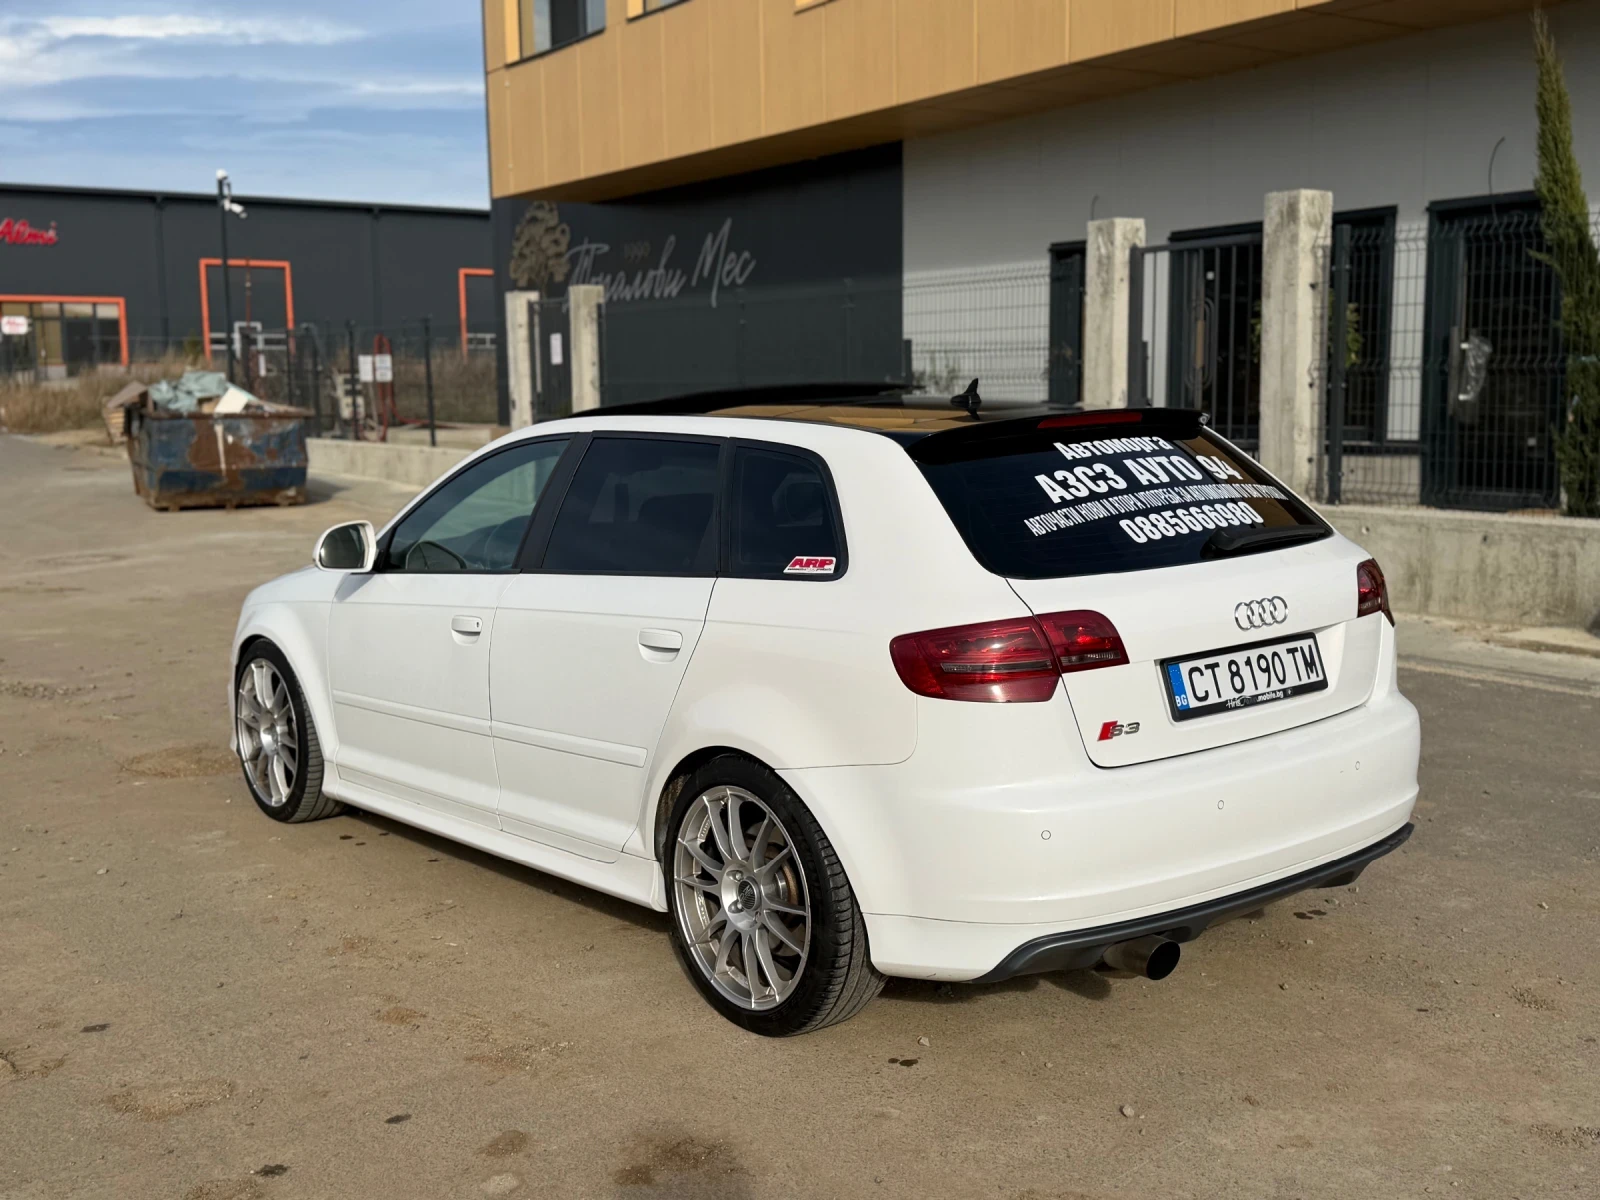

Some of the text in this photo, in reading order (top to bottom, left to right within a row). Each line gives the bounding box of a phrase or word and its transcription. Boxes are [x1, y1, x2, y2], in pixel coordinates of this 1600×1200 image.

[1053, 436, 1174, 460] Автоморга
[1196, 455, 1243, 480] 94
[1024, 506, 1085, 537] АВТОЧАСТИ
[1119, 501, 1264, 543] 0885666980
[789, 558, 834, 568] ARP
[1188, 644, 1319, 702] CT 8190 TM
[1175, 696, 1188, 706] BG
[1109, 721, 1140, 737] S3
